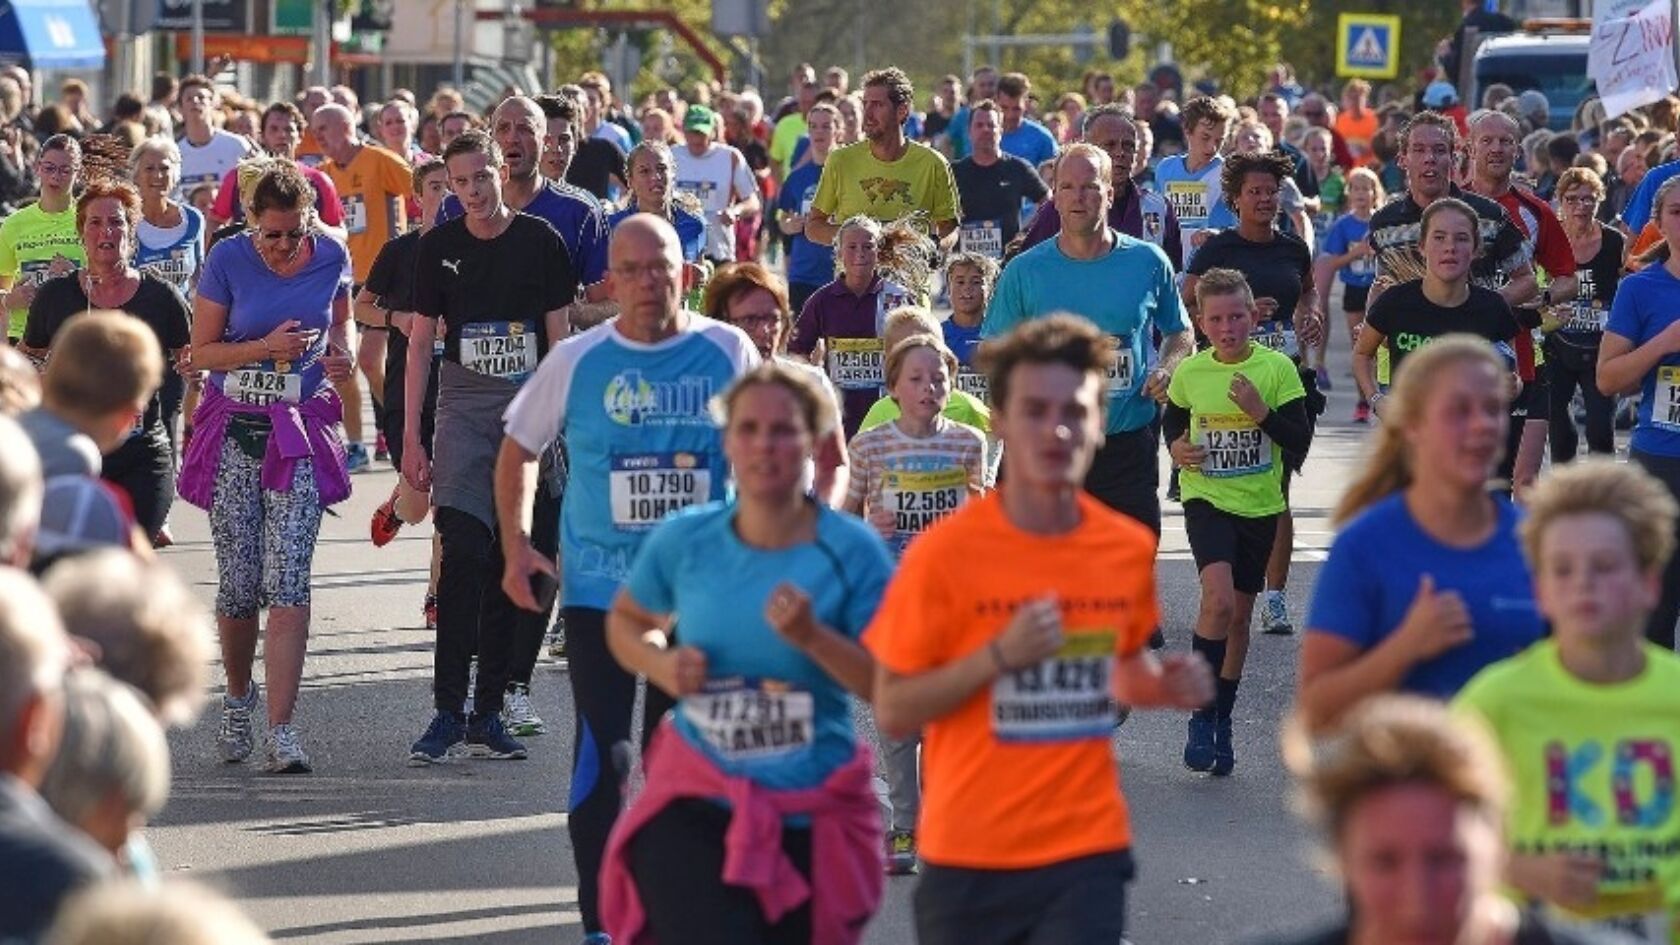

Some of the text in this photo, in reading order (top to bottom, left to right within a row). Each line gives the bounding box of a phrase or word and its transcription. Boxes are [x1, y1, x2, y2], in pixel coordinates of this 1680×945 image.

[472, 336, 526, 356] 10.204
[473, 355, 526, 375] KYLIAN
[837, 351, 881, 368] 12.590
[240, 371, 287, 391] 9.828
[1206, 428, 1263, 450] 12.359
[1210, 447, 1261, 469] TWAN
[626, 473, 696, 494] 10.790
[895, 488, 957, 511] 12.583
